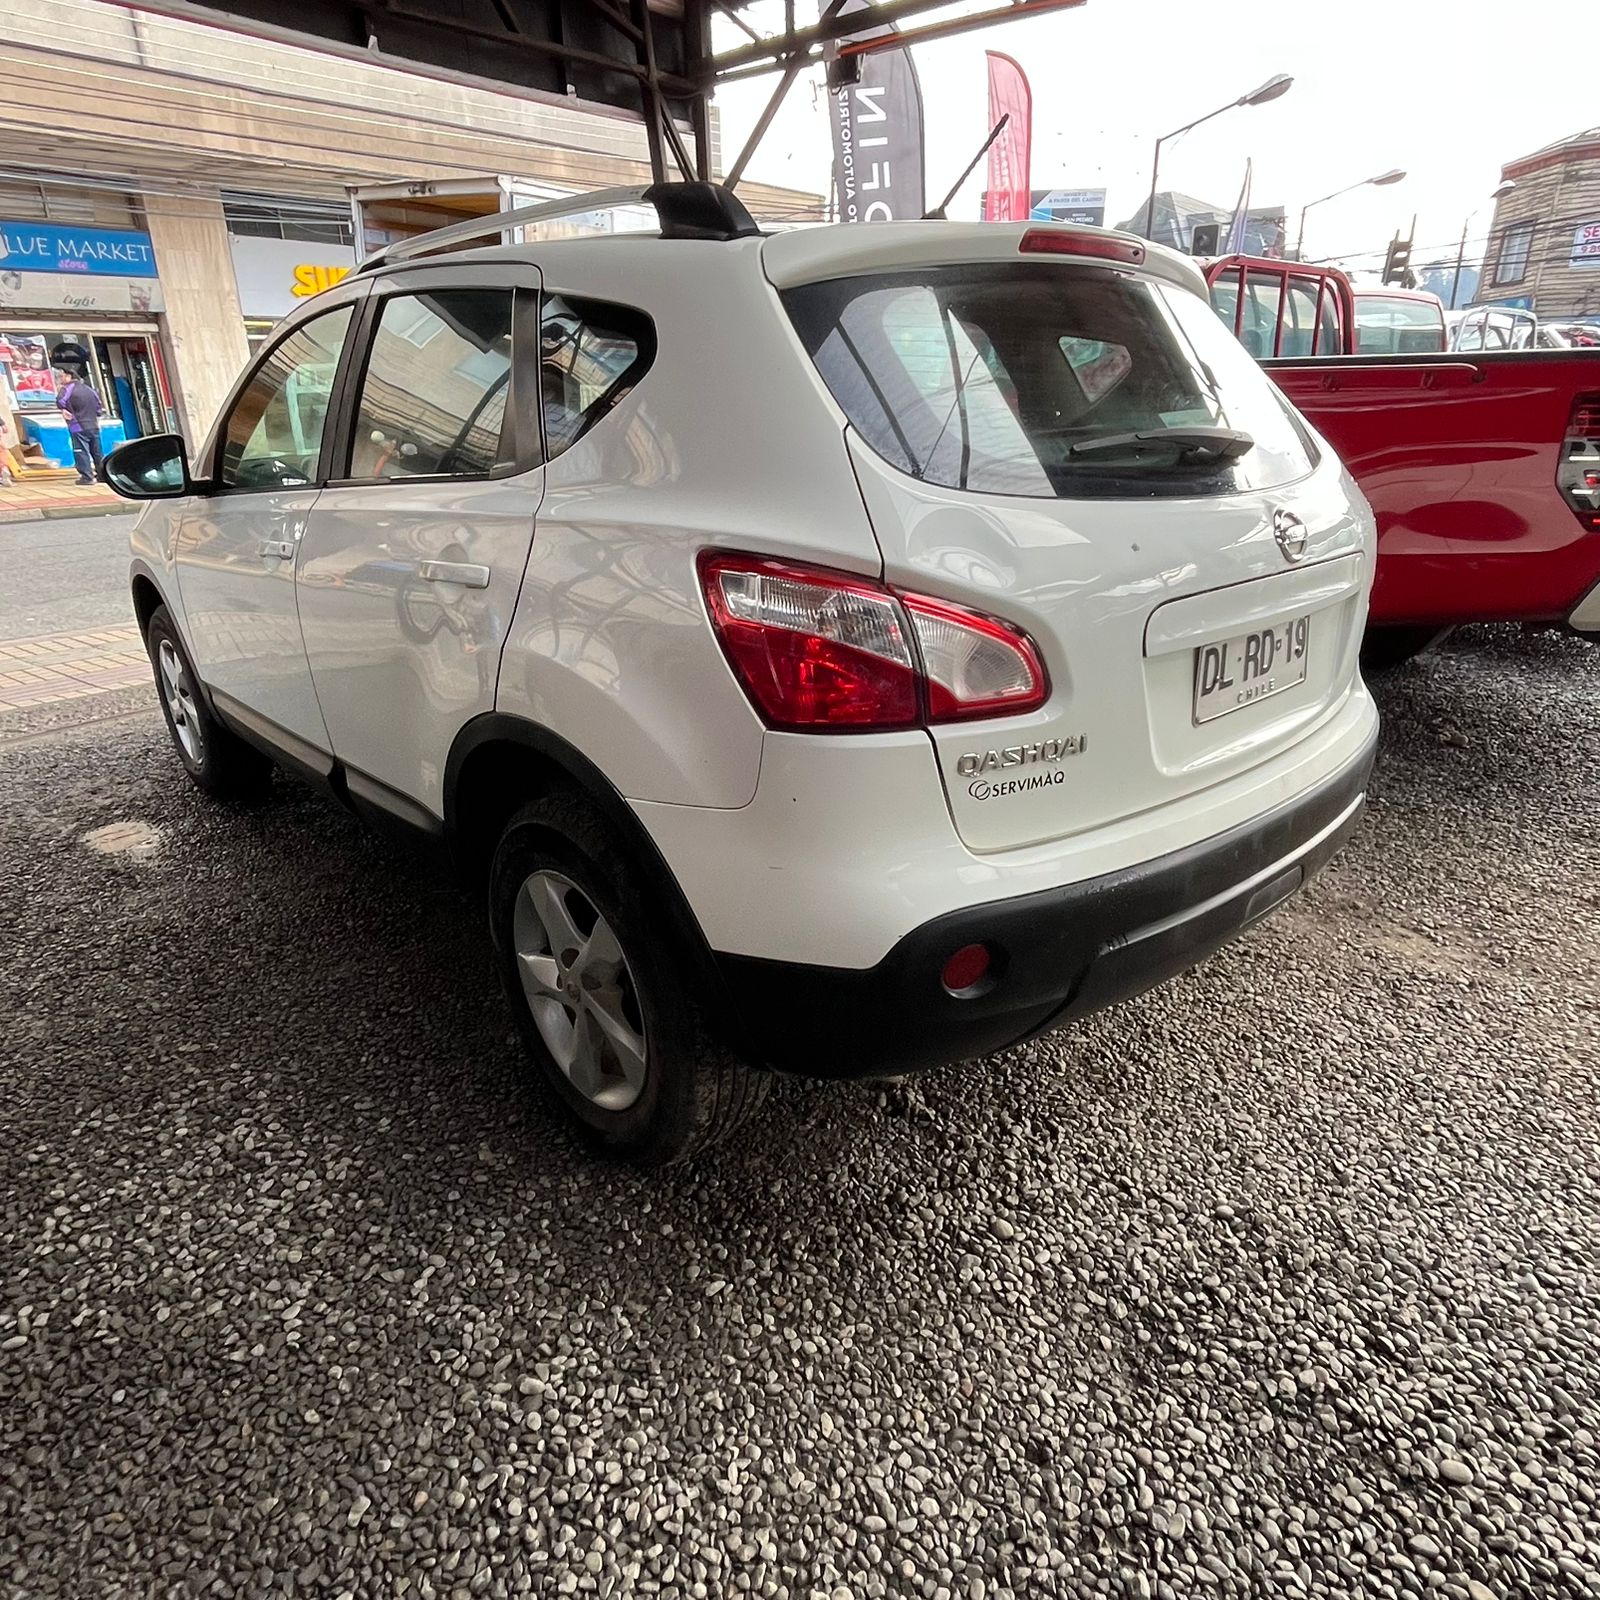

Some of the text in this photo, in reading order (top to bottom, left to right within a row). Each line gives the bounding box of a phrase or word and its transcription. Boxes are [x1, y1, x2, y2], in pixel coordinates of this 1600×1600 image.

[0, 233, 151, 262] LUE MARKET
[63, 294, 96, 307] light
[1236, 677, 1275, 704] CHILE
[957, 732, 1088, 778] QASHQAI
[991, 770, 1065, 797] SERVIMAQ
